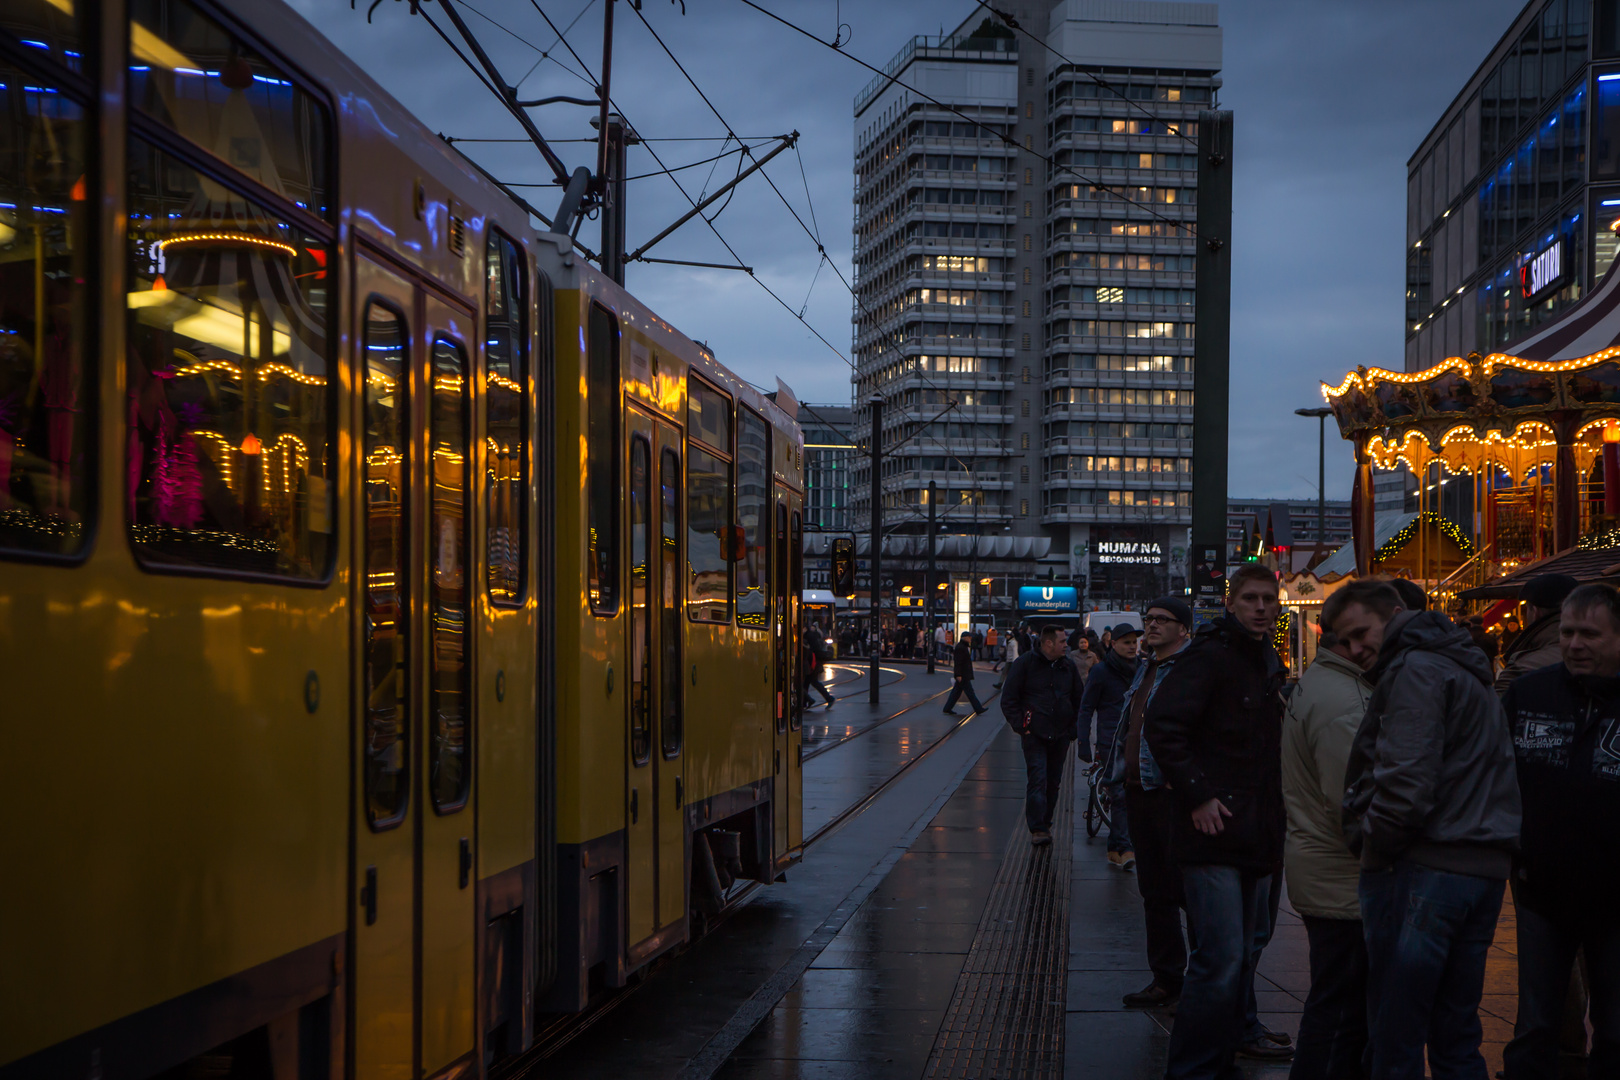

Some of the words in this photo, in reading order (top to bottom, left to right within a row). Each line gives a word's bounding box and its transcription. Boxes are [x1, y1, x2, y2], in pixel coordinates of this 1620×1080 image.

[1531, 241, 1560, 295] SATURN
[1098, 541, 1161, 554] HUMANA
[1099, 555, 1161, 564] SECOND-HAND
[810, 570, 829, 583] FIT
[1042, 586, 1054, 600] U
[1025, 600, 1071, 609] Alexanderplatz
[1538, 738, 1563, 746] DAVID
